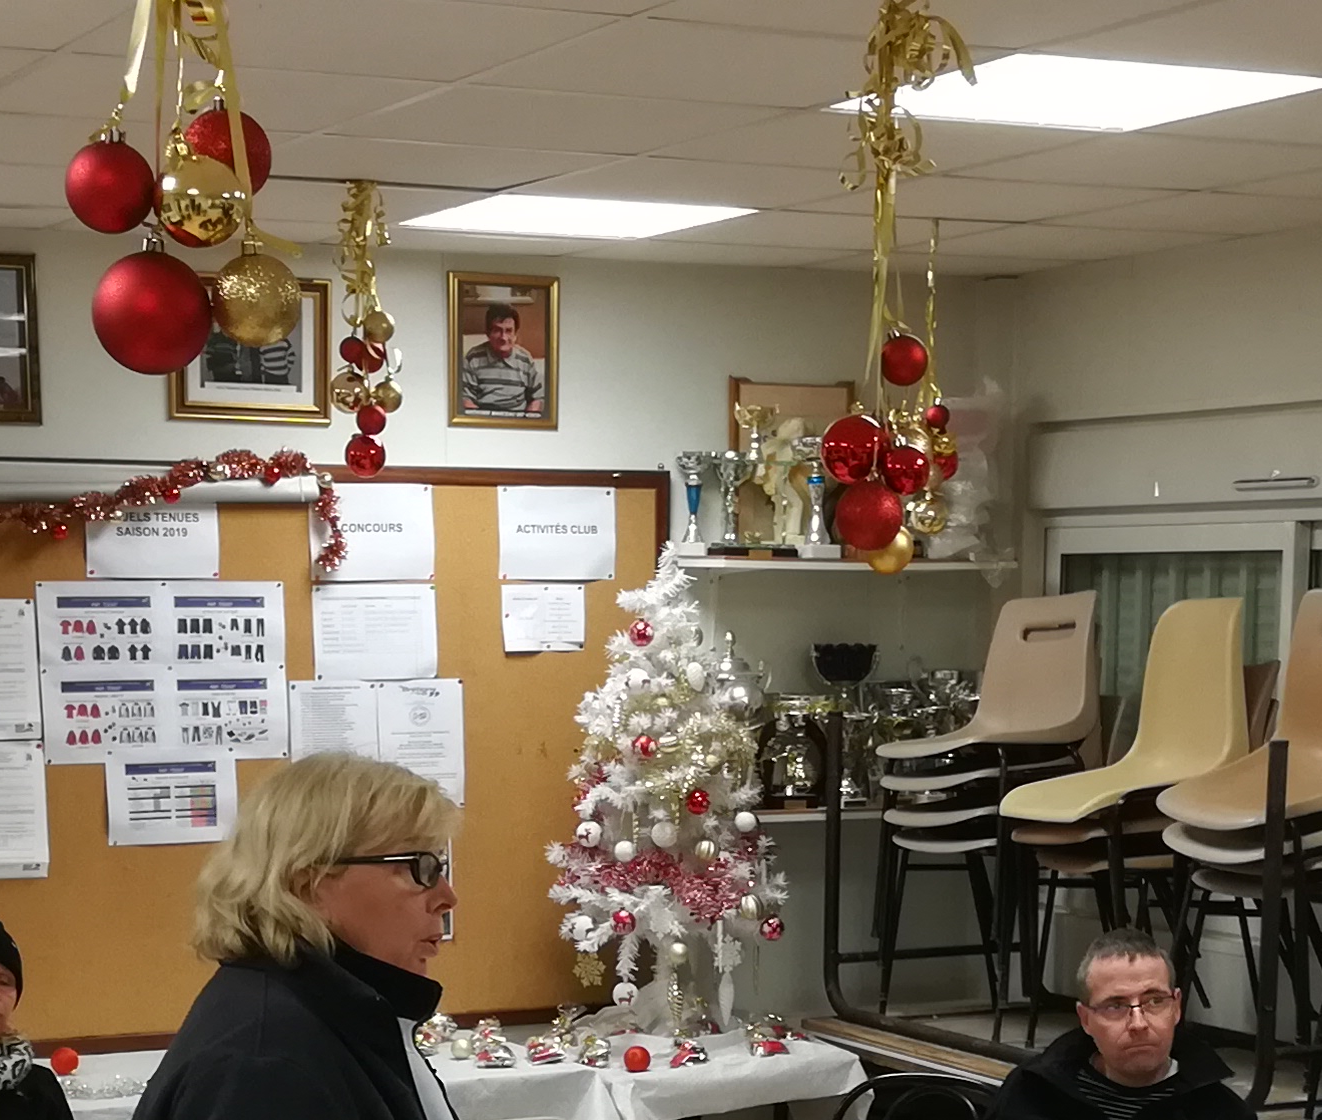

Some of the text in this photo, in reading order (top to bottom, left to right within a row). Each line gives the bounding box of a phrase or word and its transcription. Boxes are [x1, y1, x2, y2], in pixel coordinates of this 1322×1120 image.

[153, 512, 200, 523] TENUES
[115, 526, 188, 537] SAISON 2019
[340, 523, 404, 534] CONCOURS
[515, 522, 599, 535] ACTIVITÉS CLUB
